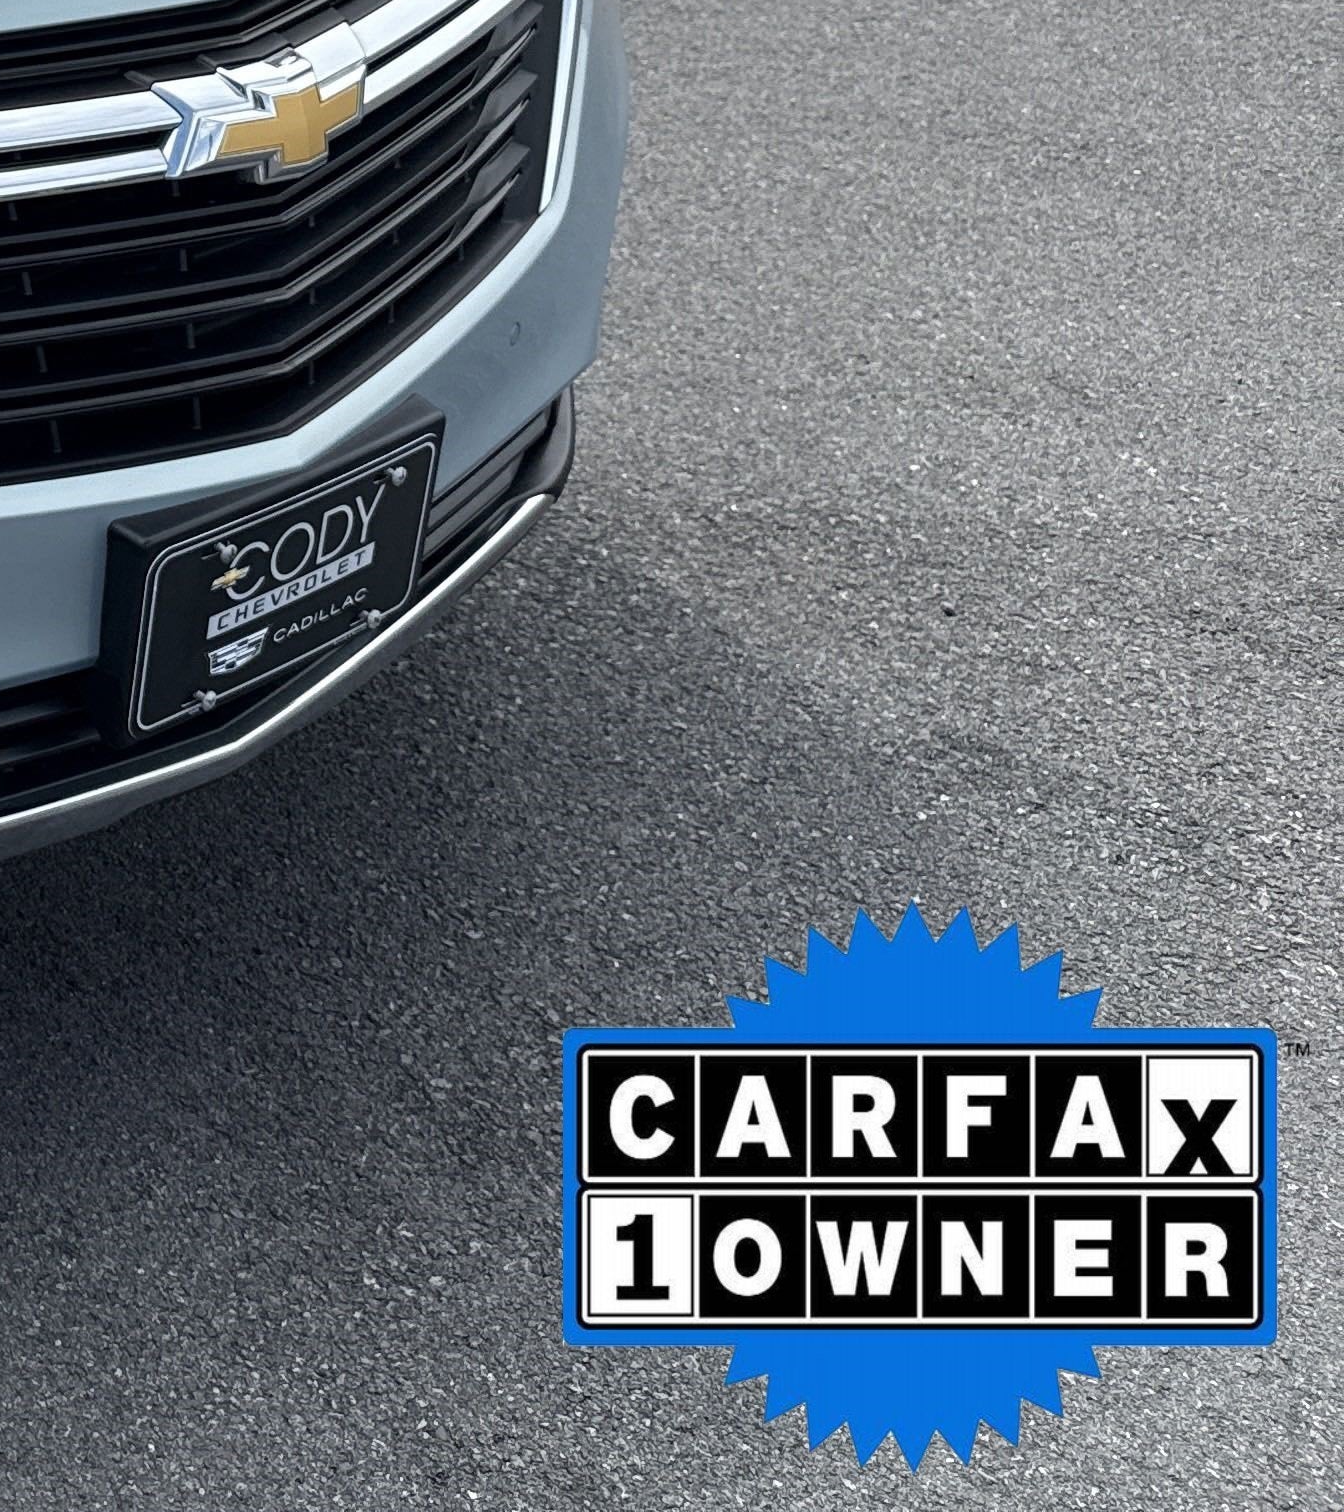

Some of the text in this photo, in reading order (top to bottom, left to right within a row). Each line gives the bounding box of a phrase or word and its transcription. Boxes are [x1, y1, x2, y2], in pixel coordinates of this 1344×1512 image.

[226, 484, 385, 601] CODY
[216, 549, 366, 631] CHEVROLET
[273, 587, 368, 643] CADILLAC
